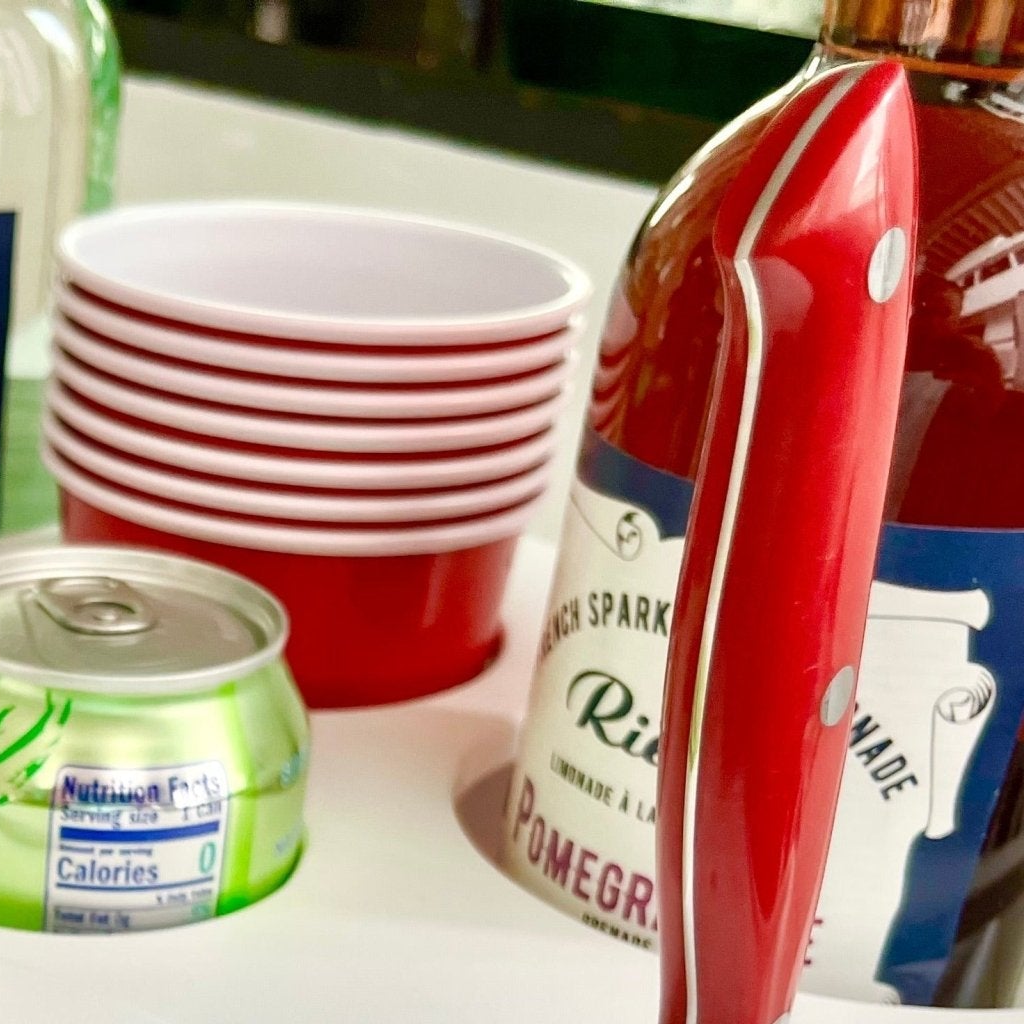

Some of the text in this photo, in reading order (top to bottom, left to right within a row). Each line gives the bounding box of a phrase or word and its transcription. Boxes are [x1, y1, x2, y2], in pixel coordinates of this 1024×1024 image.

[587, 590, 671, 638] SPARK
[849, 702, 919, 802] NADE
[63, 774, 160, 805] Nutrition
[549, 751, 615, 808] LIMONADE
[60, 804, 122, 830] Serving
[56, 841, 217, 885] Calories 0
[512, 775, 659, 932] POMEGR
